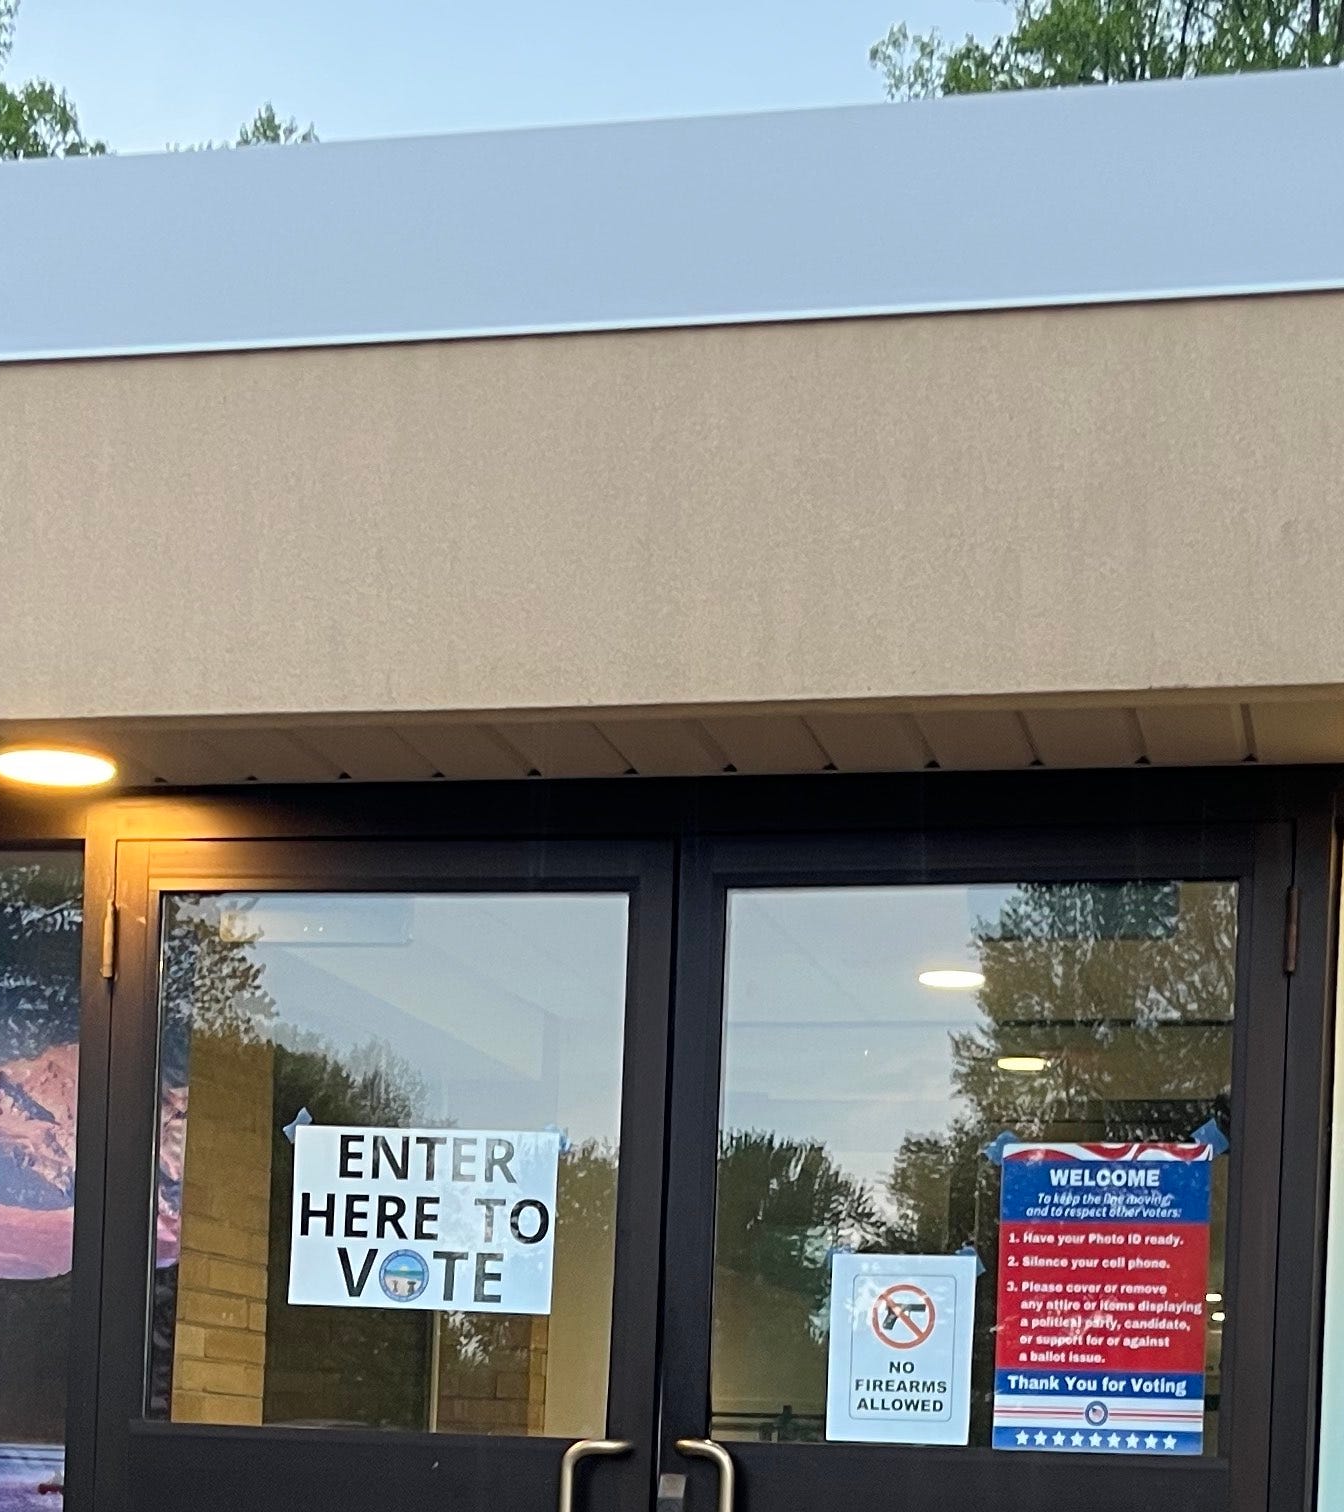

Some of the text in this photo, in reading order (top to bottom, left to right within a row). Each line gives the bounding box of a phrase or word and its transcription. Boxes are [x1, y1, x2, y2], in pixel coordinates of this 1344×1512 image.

[338, 1134, 518, 1184] ENTER
[1049, 1169, 1161, 1187] WELCOME
[1037, 1192, 1052, 1205] To
[1053, 1192, 1080, 1207] keep
[1082, 1192, 1102, 1206] the
[300, 1192, 550, 1245] HERE TO
[1025, 1205, 1049, 1217] and
[1051, 1206, 1064, 1217] to
[1064, 1207, 1107, 1220] respect
[1108, 1206, 1141, 1218] other
[1008, 1232, 1185, 1247] 1. Have your Photo ID ready.
[1007, 1256, 1171, 1272] 2. Silence your cell phone.
[1006, 1280, 1168, 1295] 3. Please cover or remove
[1020, 1299, 1203, 1315] any attire or items displaying
[1020, 1316, 1192, 1332] a political party, candidate,
[1019, 1334, 1171, 1350] or support for or against
[1018, 1351, 1106, 1364] a ballot issue.
[888, 1361, 916, 1375] NO
[854, 1379, 947, 1394] FIREARMS
[1006, 1374, 1188, 1397] Thank You for Voting
[856, 1397, 944, 1413] ALLOWED
